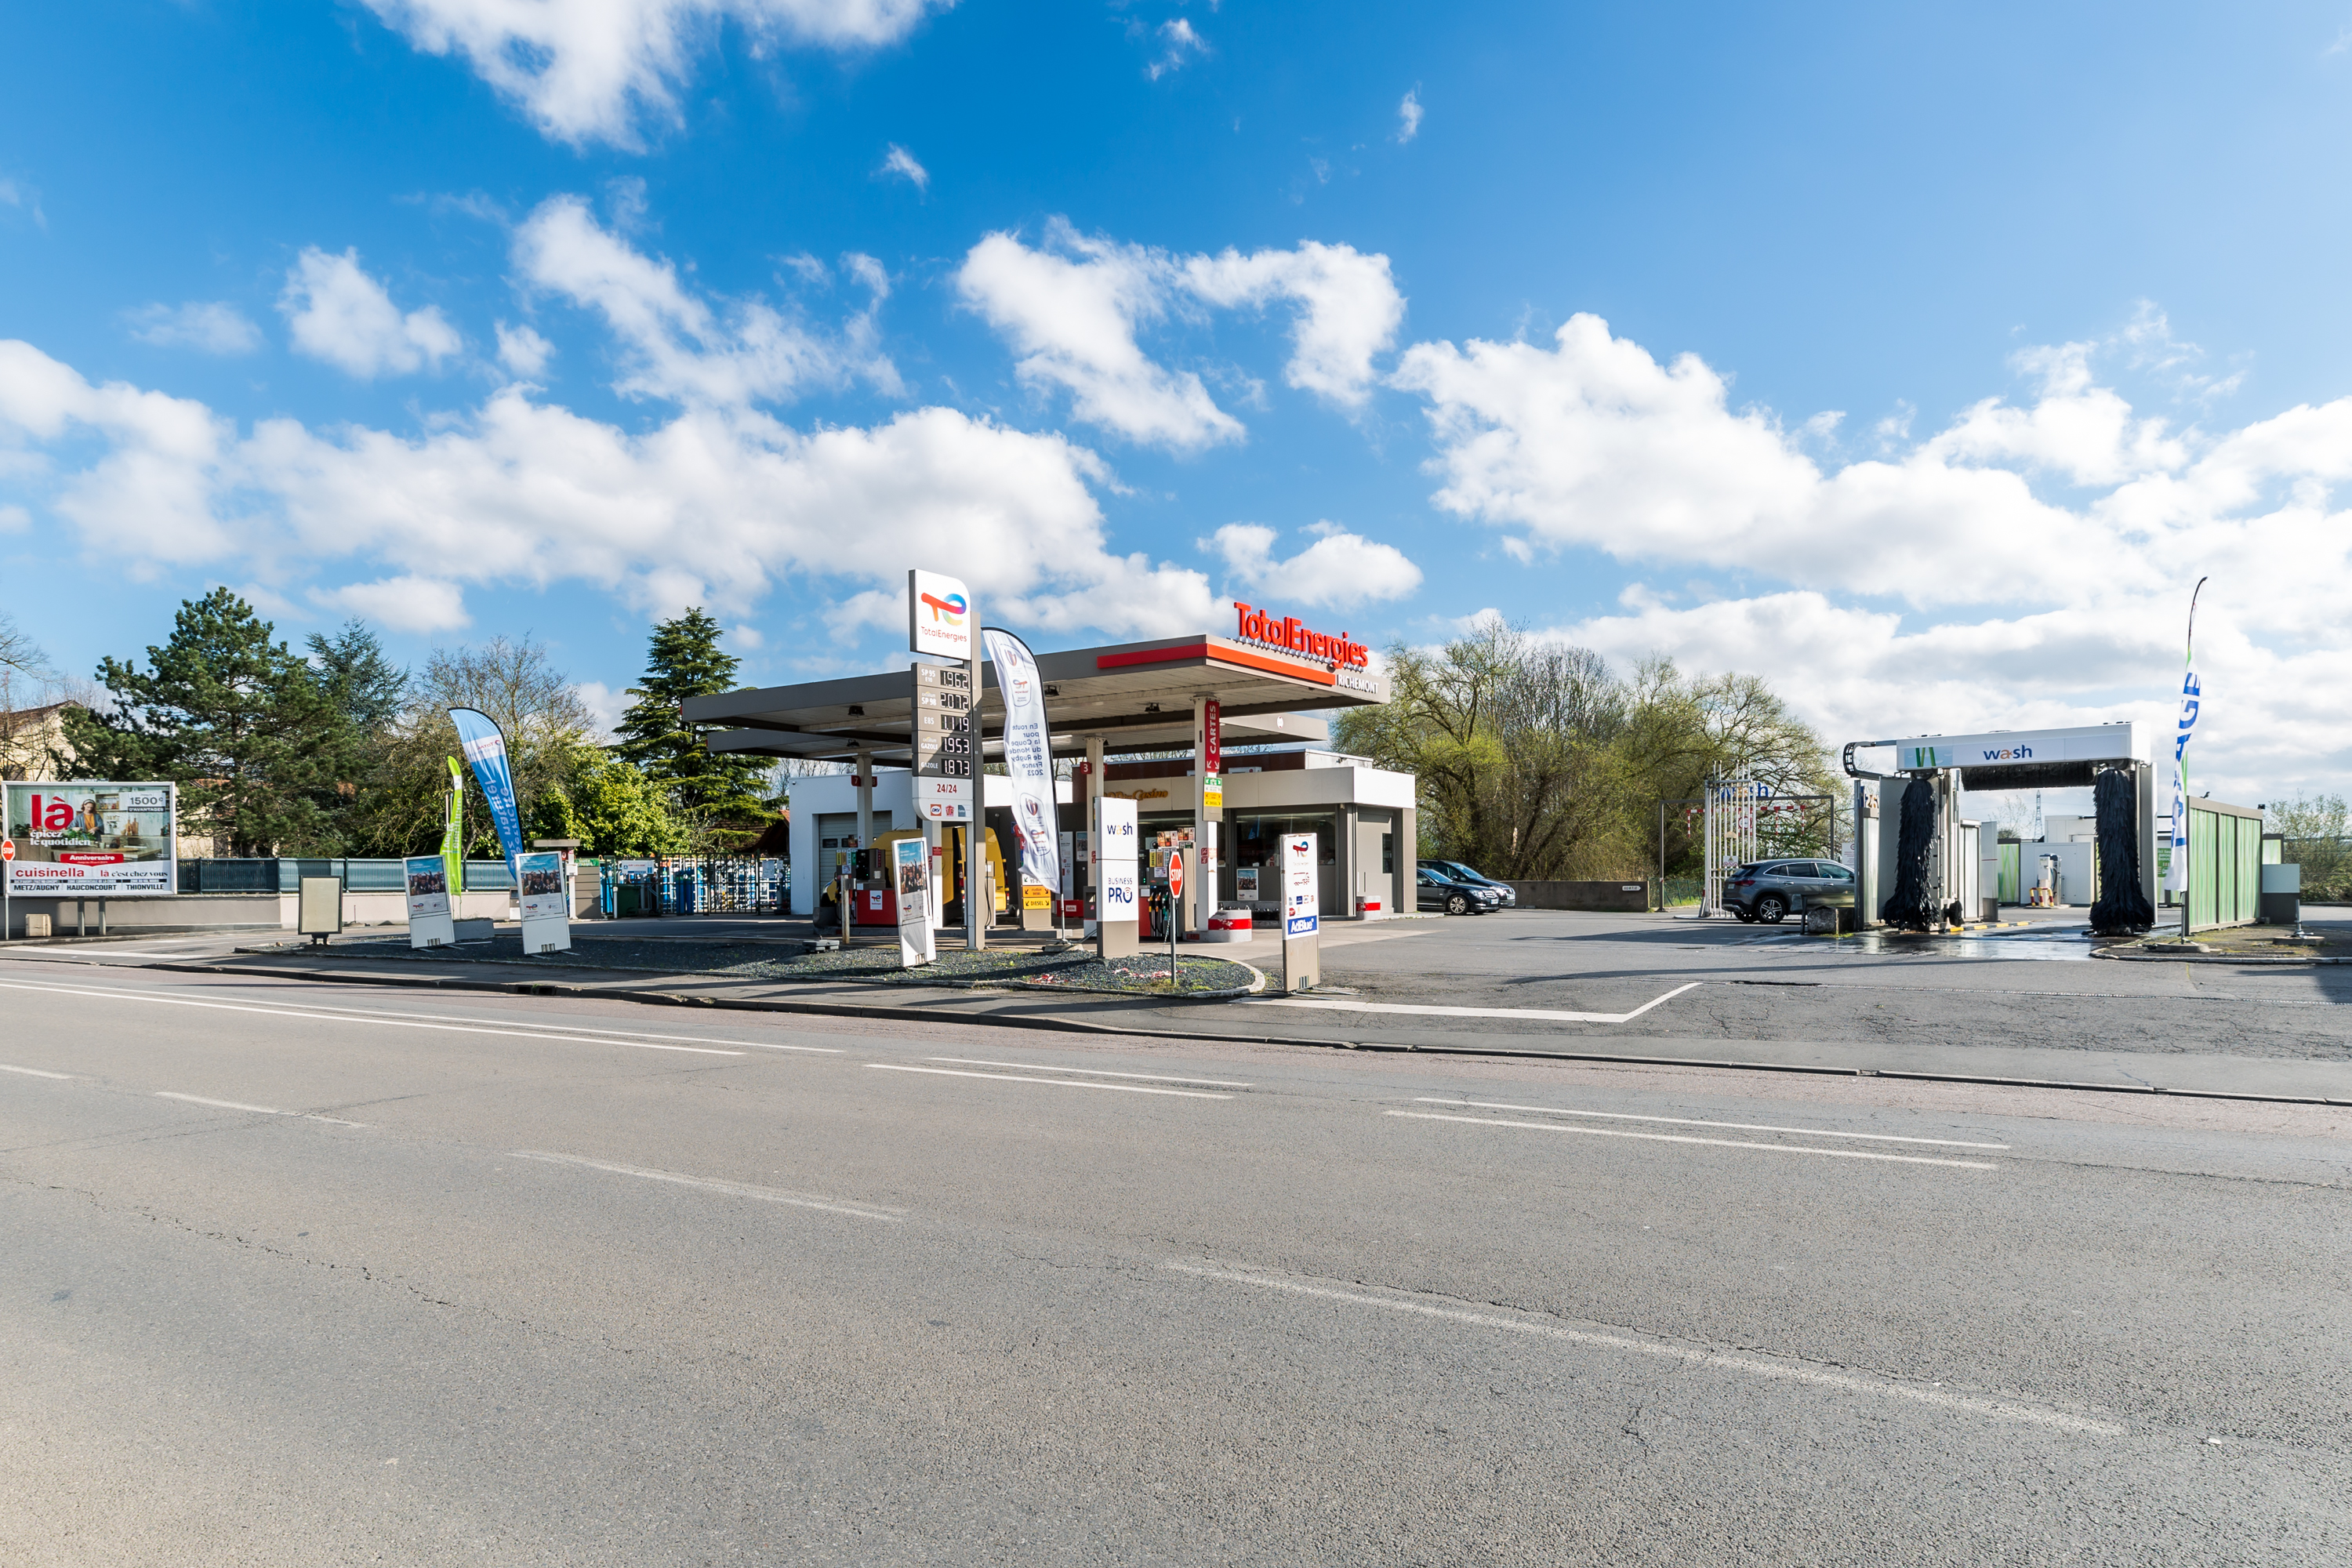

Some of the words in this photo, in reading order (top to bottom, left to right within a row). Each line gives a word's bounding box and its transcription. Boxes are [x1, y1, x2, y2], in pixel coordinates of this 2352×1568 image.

[920, 626, 967, 642] TotalEnergies
[1234, 601, 1369, 669] TotalEnergies
[943, 672, 968, 689] 1.962
[1338, 673, 1380, 694] RICHEMONT
[944, 716, 969, 732] 1.119
[944, 738, 970, 753] 1.953
[1983, 744, 2032, 760] wash
[944, 760, 970, 775] 1.873
[1083, 764, 1088, 772] 3
[937, 783, 957, 793] 24/24
[31, 794, 74, 831] là
[1107, 822, 1133, 835] wash
[41, 838, 91, 847] quotidien
[16, 868, 84, 877] cuisinella
[1171, 869, 1181, 881] STOP
[1109, 887, 1132, 903] PRO
